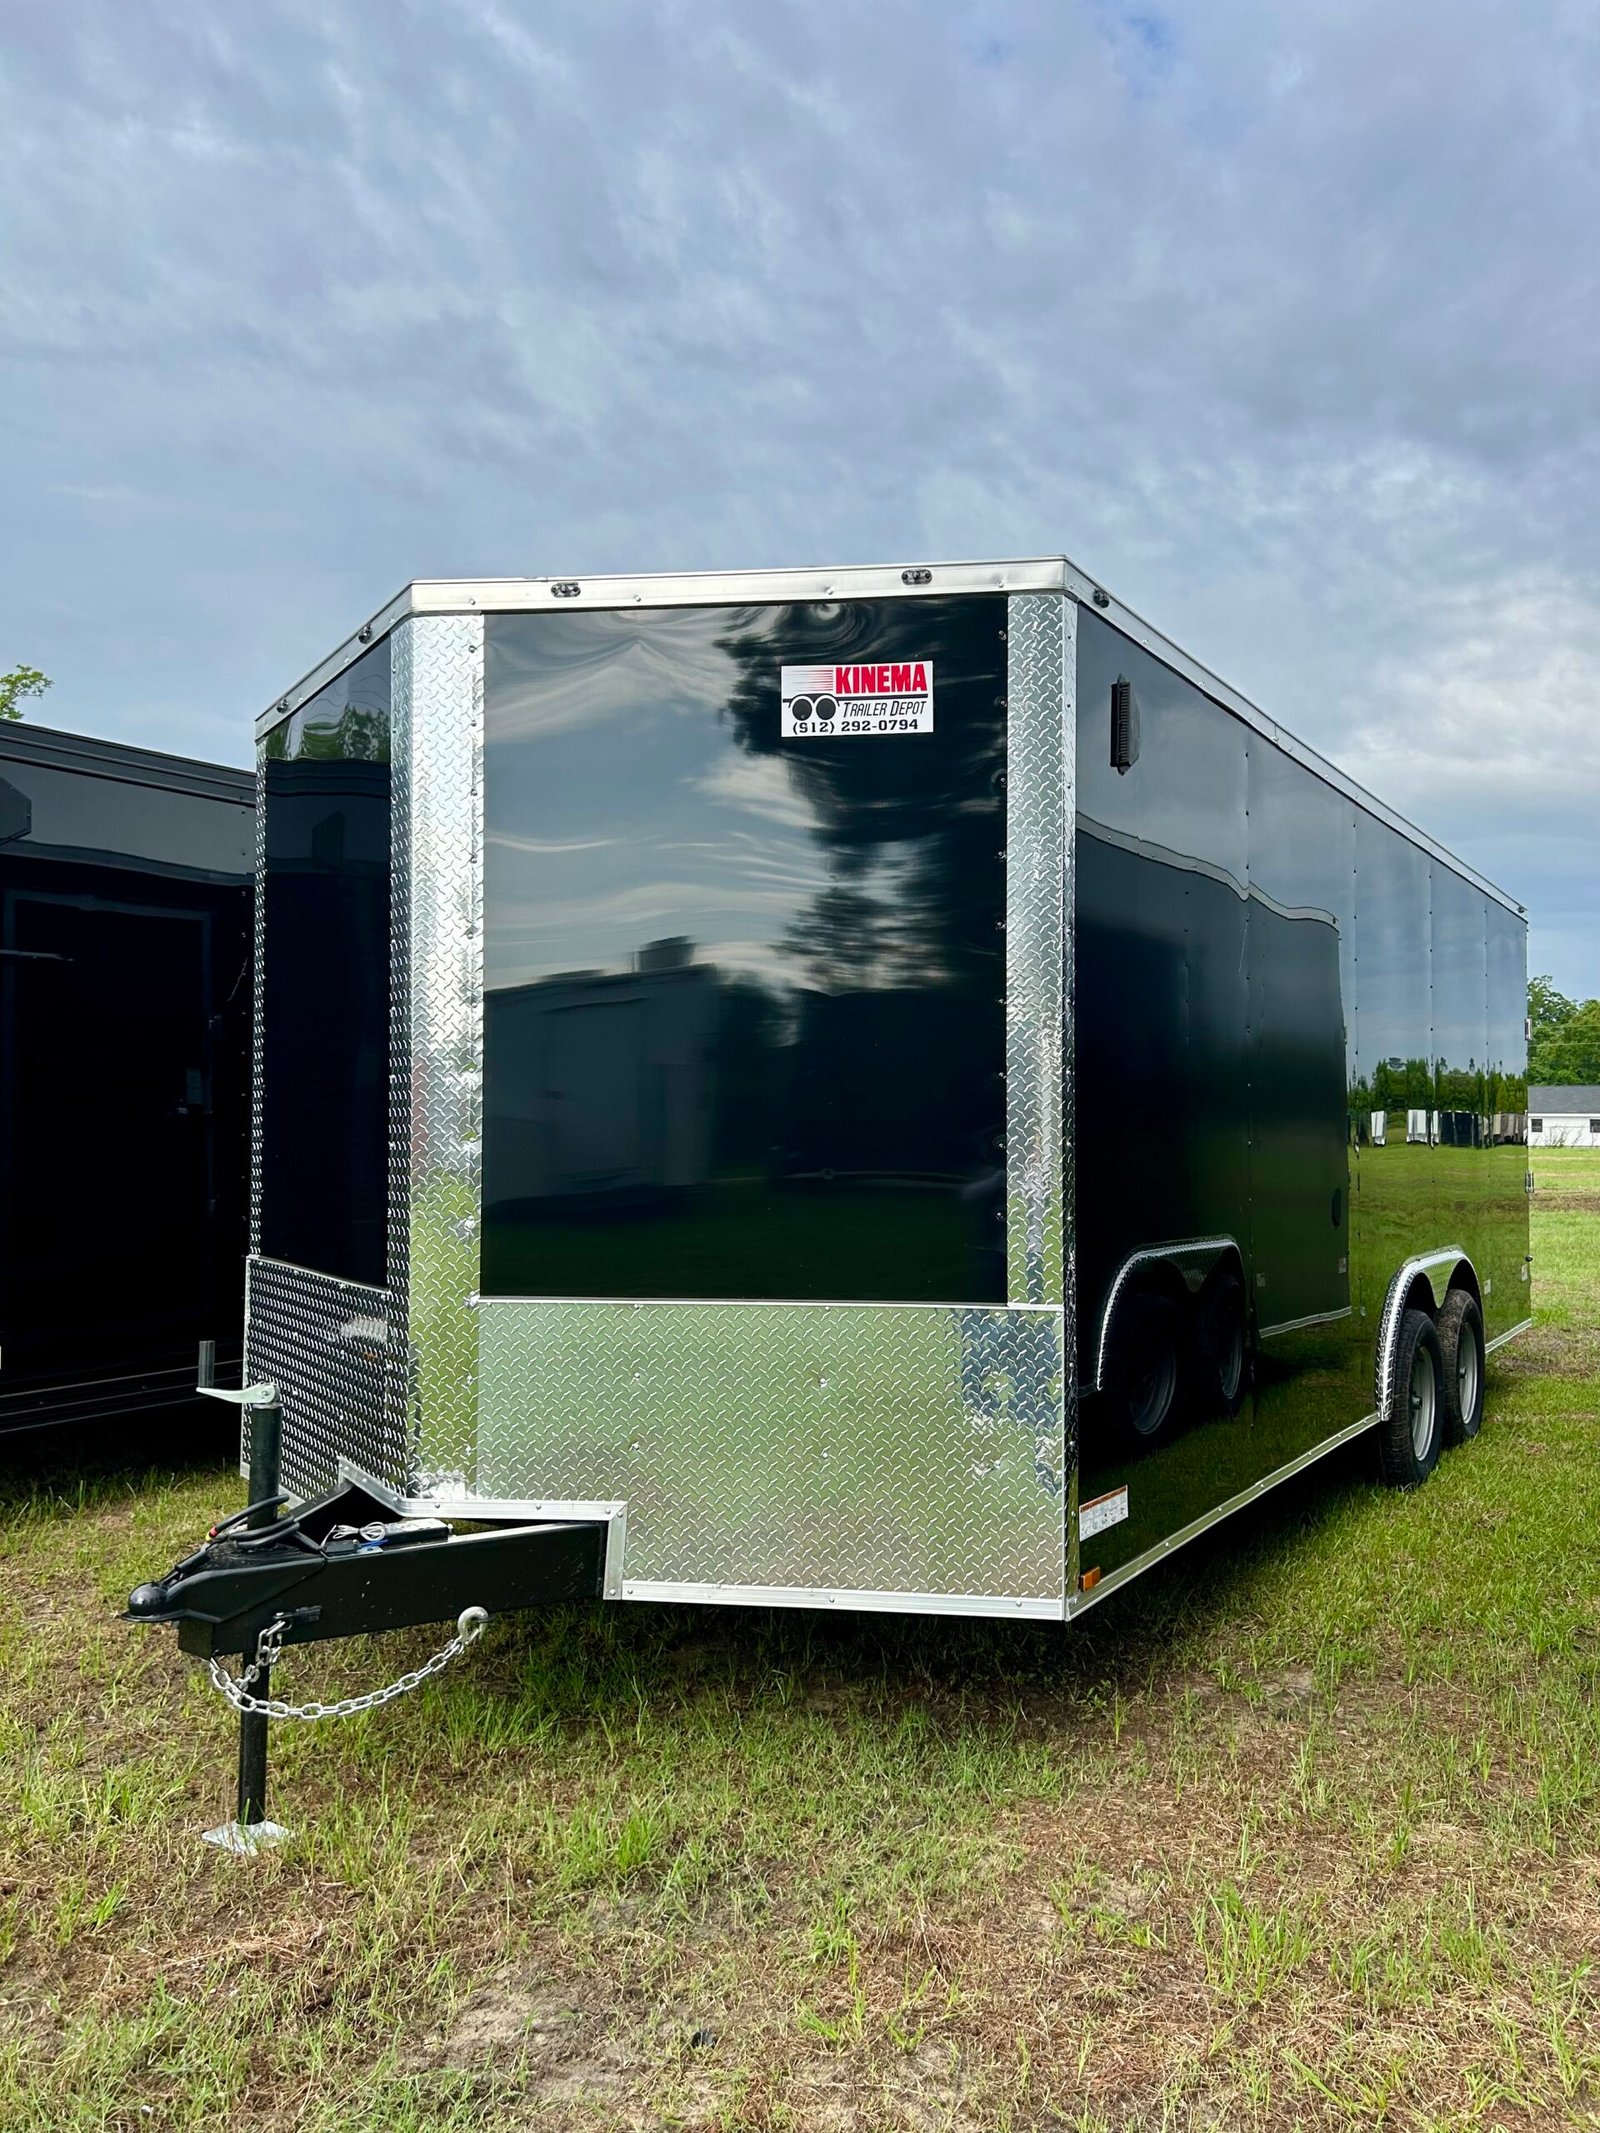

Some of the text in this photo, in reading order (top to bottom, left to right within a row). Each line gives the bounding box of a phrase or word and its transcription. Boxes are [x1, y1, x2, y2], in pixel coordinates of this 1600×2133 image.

[836, 664, 927, 694] KINEMA
[843, 701, 927, 718] TRAILER DEPOT
[792, 719, 918, 735] (912) 292-0794
